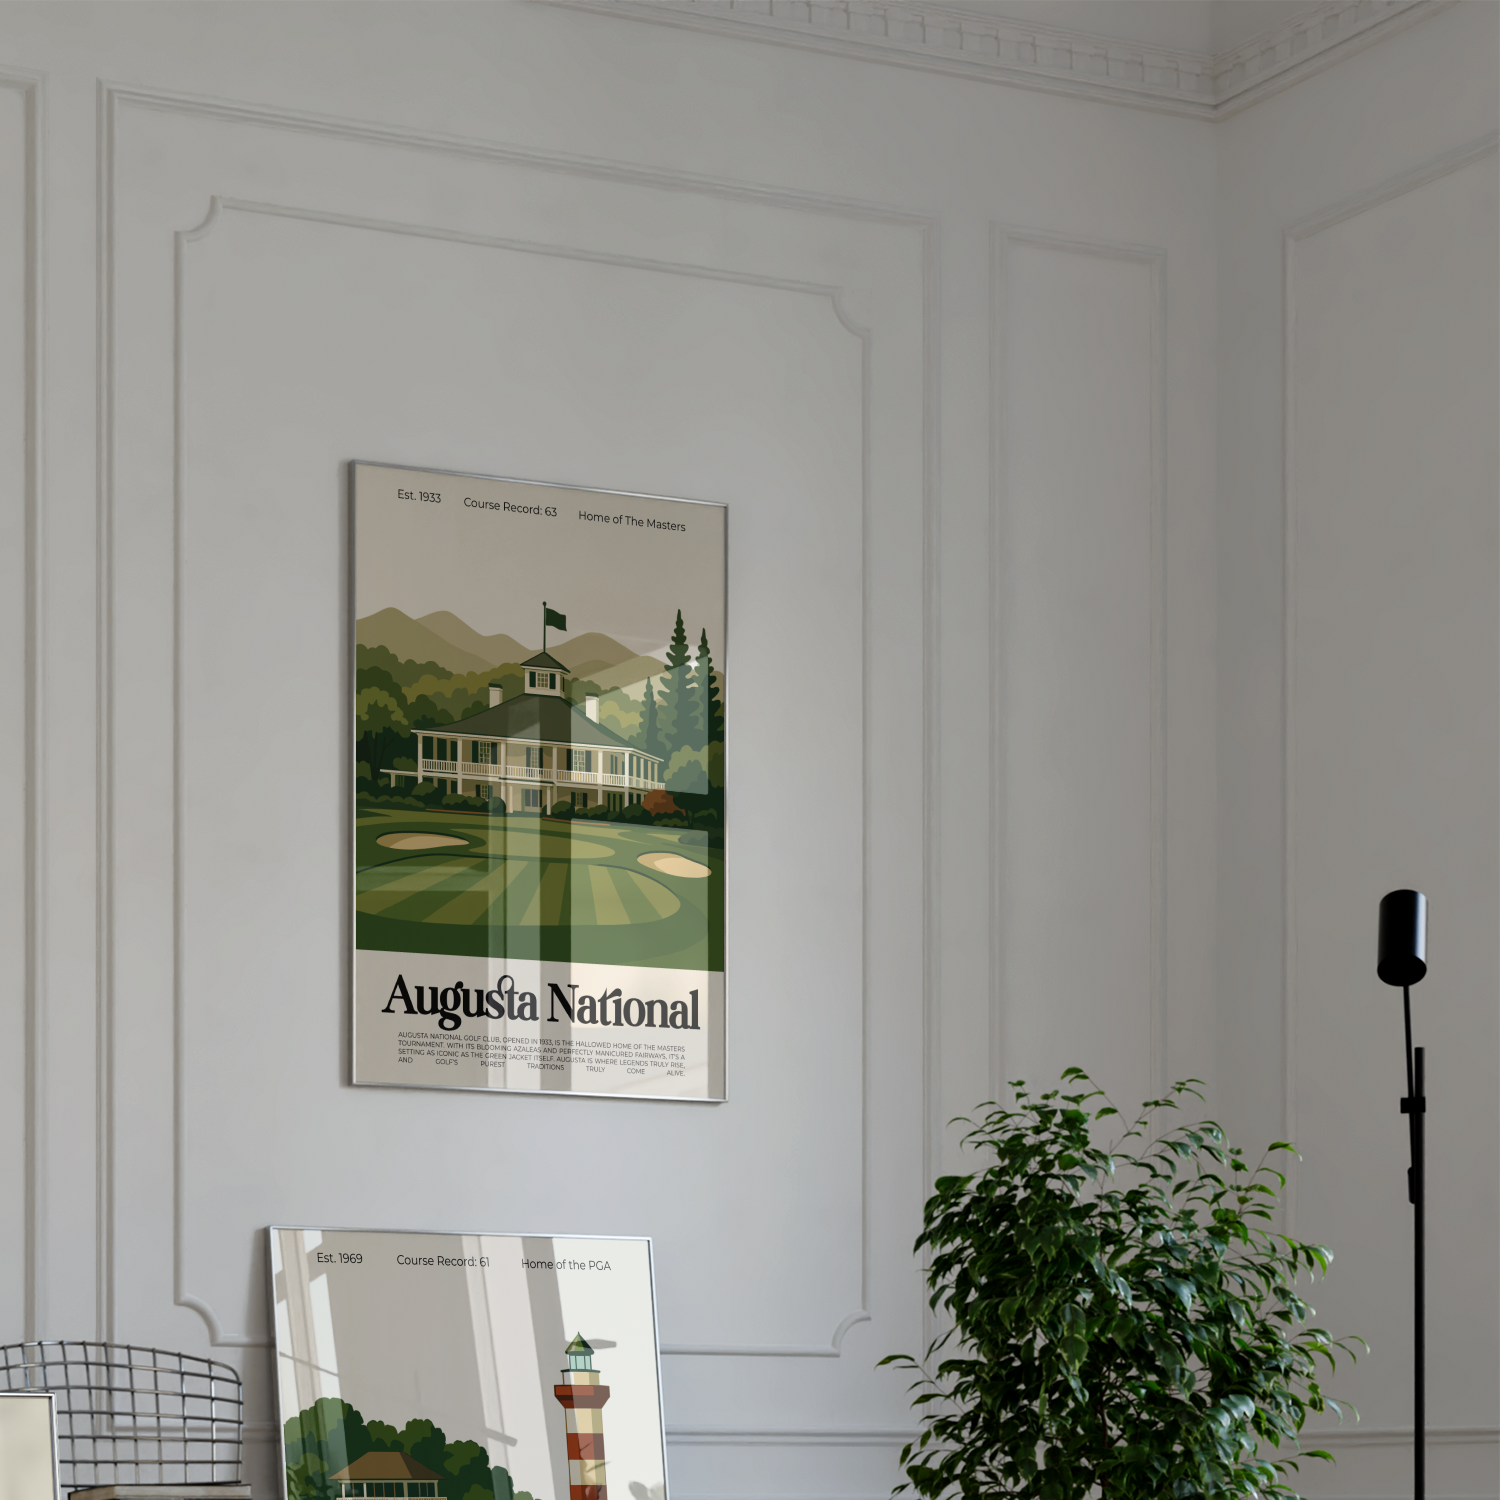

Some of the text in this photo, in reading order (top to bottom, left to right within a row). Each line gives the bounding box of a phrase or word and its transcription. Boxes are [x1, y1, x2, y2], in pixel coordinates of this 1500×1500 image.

[397, 488, 442, 504] Est. 1933
[463, 496, 558, 518] Course Record: 63
[578, 510, 687, 532] Home of The Masters
[381, 973, 702, 1032] Augusta National
[397, 1031, 429, 1039] AUGUSTA
[429, 1033, 463, 1042] NATIONAL
[463, 1034, 482, 1042] GOLF
[482, 1035, 502, 1044] CLUB,
[502, 1036, 530, 1045] OPENED
[539, 1038, 554, 1047] 1933,
[554, 1039, 561, 1047] IS
[561, 1039, 575, 1047] THE
[575, 1040, 612, 1049] HALLOWED
[612, 1042, 633, 1050] HOME
[643, 1043, 656, 1051] THE
[656, 1045, 686, 1053] MASTERS
[397, 1039, 445, 1049] TOURNAMENT.
[446, 1042, 464, 1050] WITH
[465, 1042, 476, 1050] ITS
[476, 1043, 512, 1052] BLOOMING
[512, 1045, 542, 1054] AZALEAS
[558, 1047, 594, 1056] PERFECTLY
[595, 1049, 634, 1058] MANICURED
[634, 1051, 668, 1060] FAIRWAYS,
[668, 1053, 680, 1061] IT'S
[397, 1047, 425, 1056] SETTING
[426, 1049, 436, 1057] AS
[436, 1050, 460, 1058] ICONIC
[470, 1051, 484, 1059] THE
[484, 1052, 507, 1060] GREEN
[508, 1053, 533, 1061] JACKET
[533, 1054, 556, 1062] ITSELF.
[556, 1056, 587, 1064] AUGUSTA
[594, 1057, 618, 1066] WHERE
[619, 1059, 649, 1067] LEGENDS
[649, 1060, 670, 1068] TRULY
[670, 1061, 686, 1069] RISE,
[397, 1056, 686, 1077] AND GOLF'S PUREST TRADITIONS TRULY COME ALIVE.
[316, 1252, 363, 1265] Est. 1969
[396, 1254, 490, 1268] Course Record: 61
[521, 1258, 612, 1272] Home of the PGA
